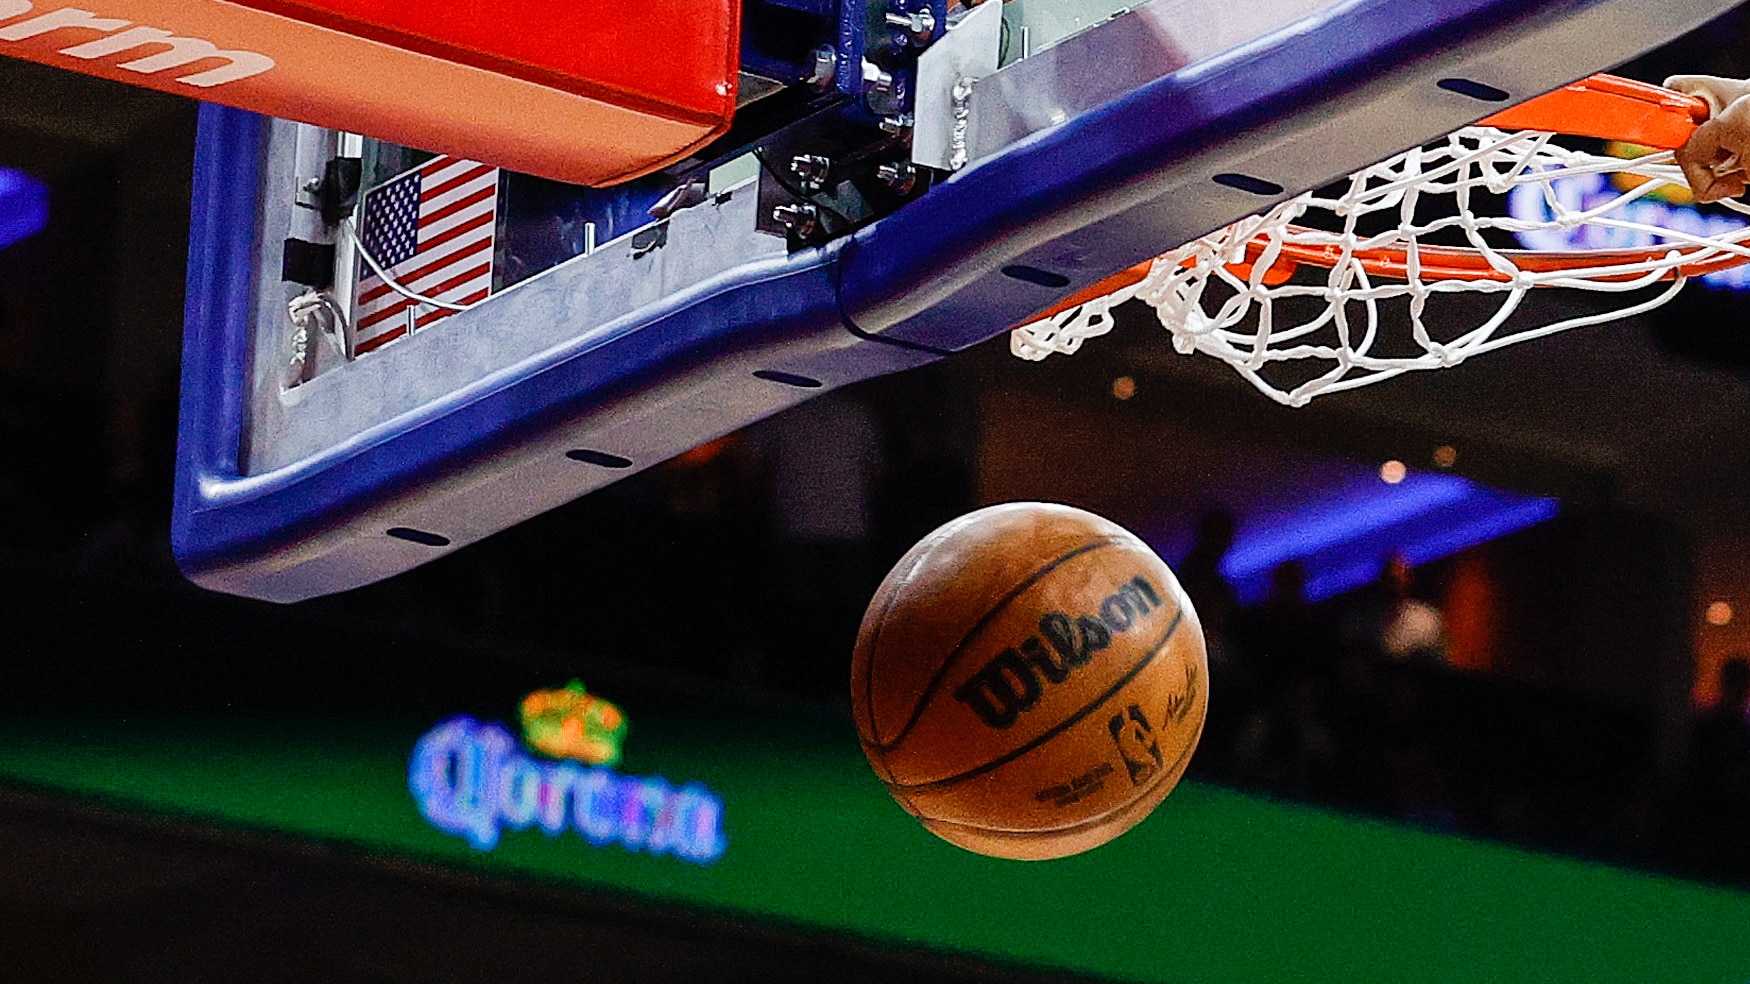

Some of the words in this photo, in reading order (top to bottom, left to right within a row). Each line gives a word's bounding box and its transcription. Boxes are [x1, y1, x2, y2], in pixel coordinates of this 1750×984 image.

[0, 0, 276, 87] rm
[955, 574, 1163, 729] Wilson
[408, 714, 727, 866] Corona
